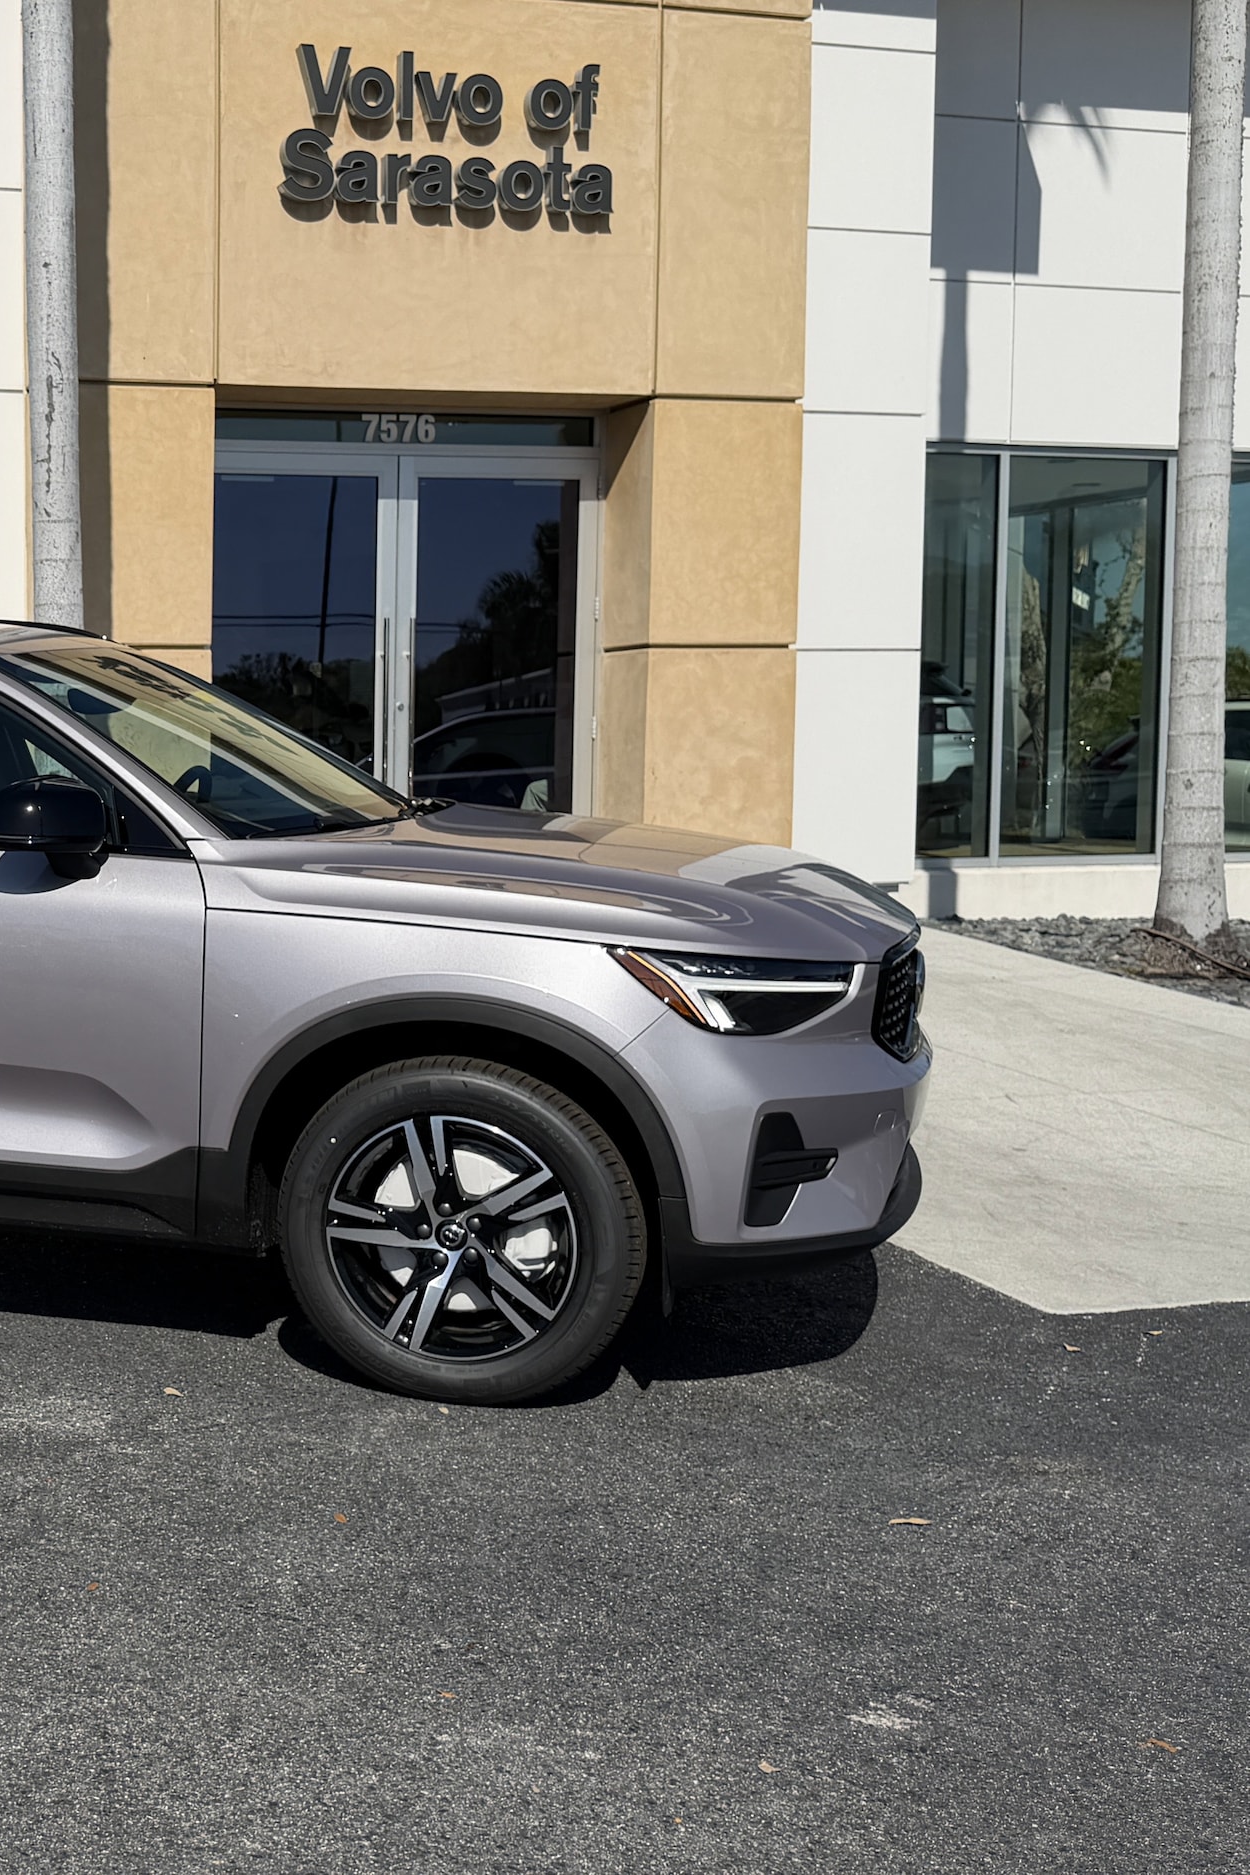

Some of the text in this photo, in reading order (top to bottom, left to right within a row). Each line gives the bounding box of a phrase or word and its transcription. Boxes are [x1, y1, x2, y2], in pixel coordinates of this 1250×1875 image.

[297, 44, 601, 131] Volvo of
[278, 128, 614, 214] Sarasota
[361, 413, 436, 443] 7576
